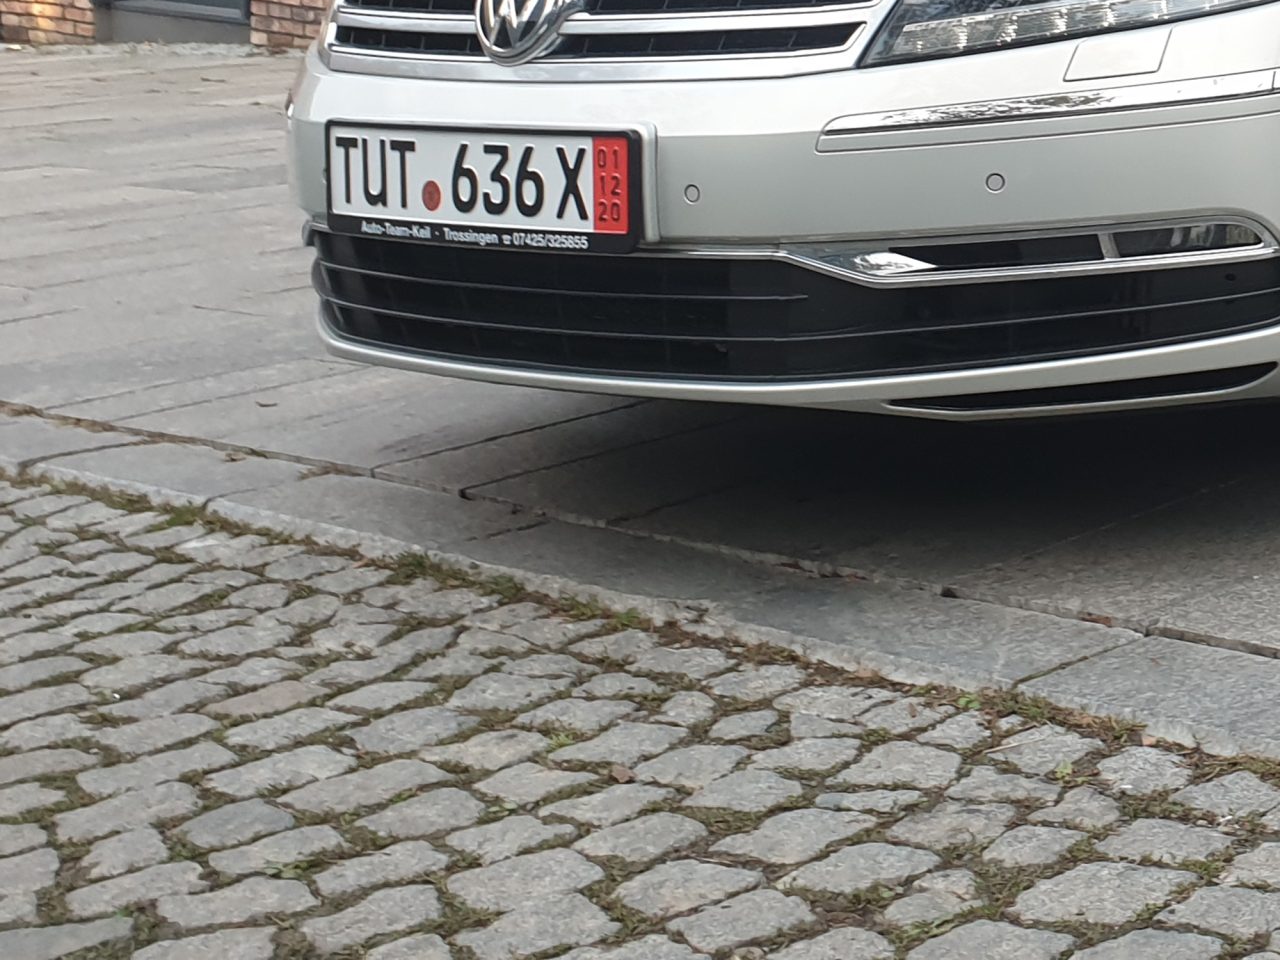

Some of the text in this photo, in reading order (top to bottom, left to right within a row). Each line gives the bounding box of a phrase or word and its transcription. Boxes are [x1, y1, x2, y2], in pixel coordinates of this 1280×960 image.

[598, 147, 619, 169] 01
[335, 136, 589, 221] TUT 636 X
[599, 172, 621, 196] 12
[598, 199, 620, 222] 20
[442, 227, 499, 246] Trossingen
